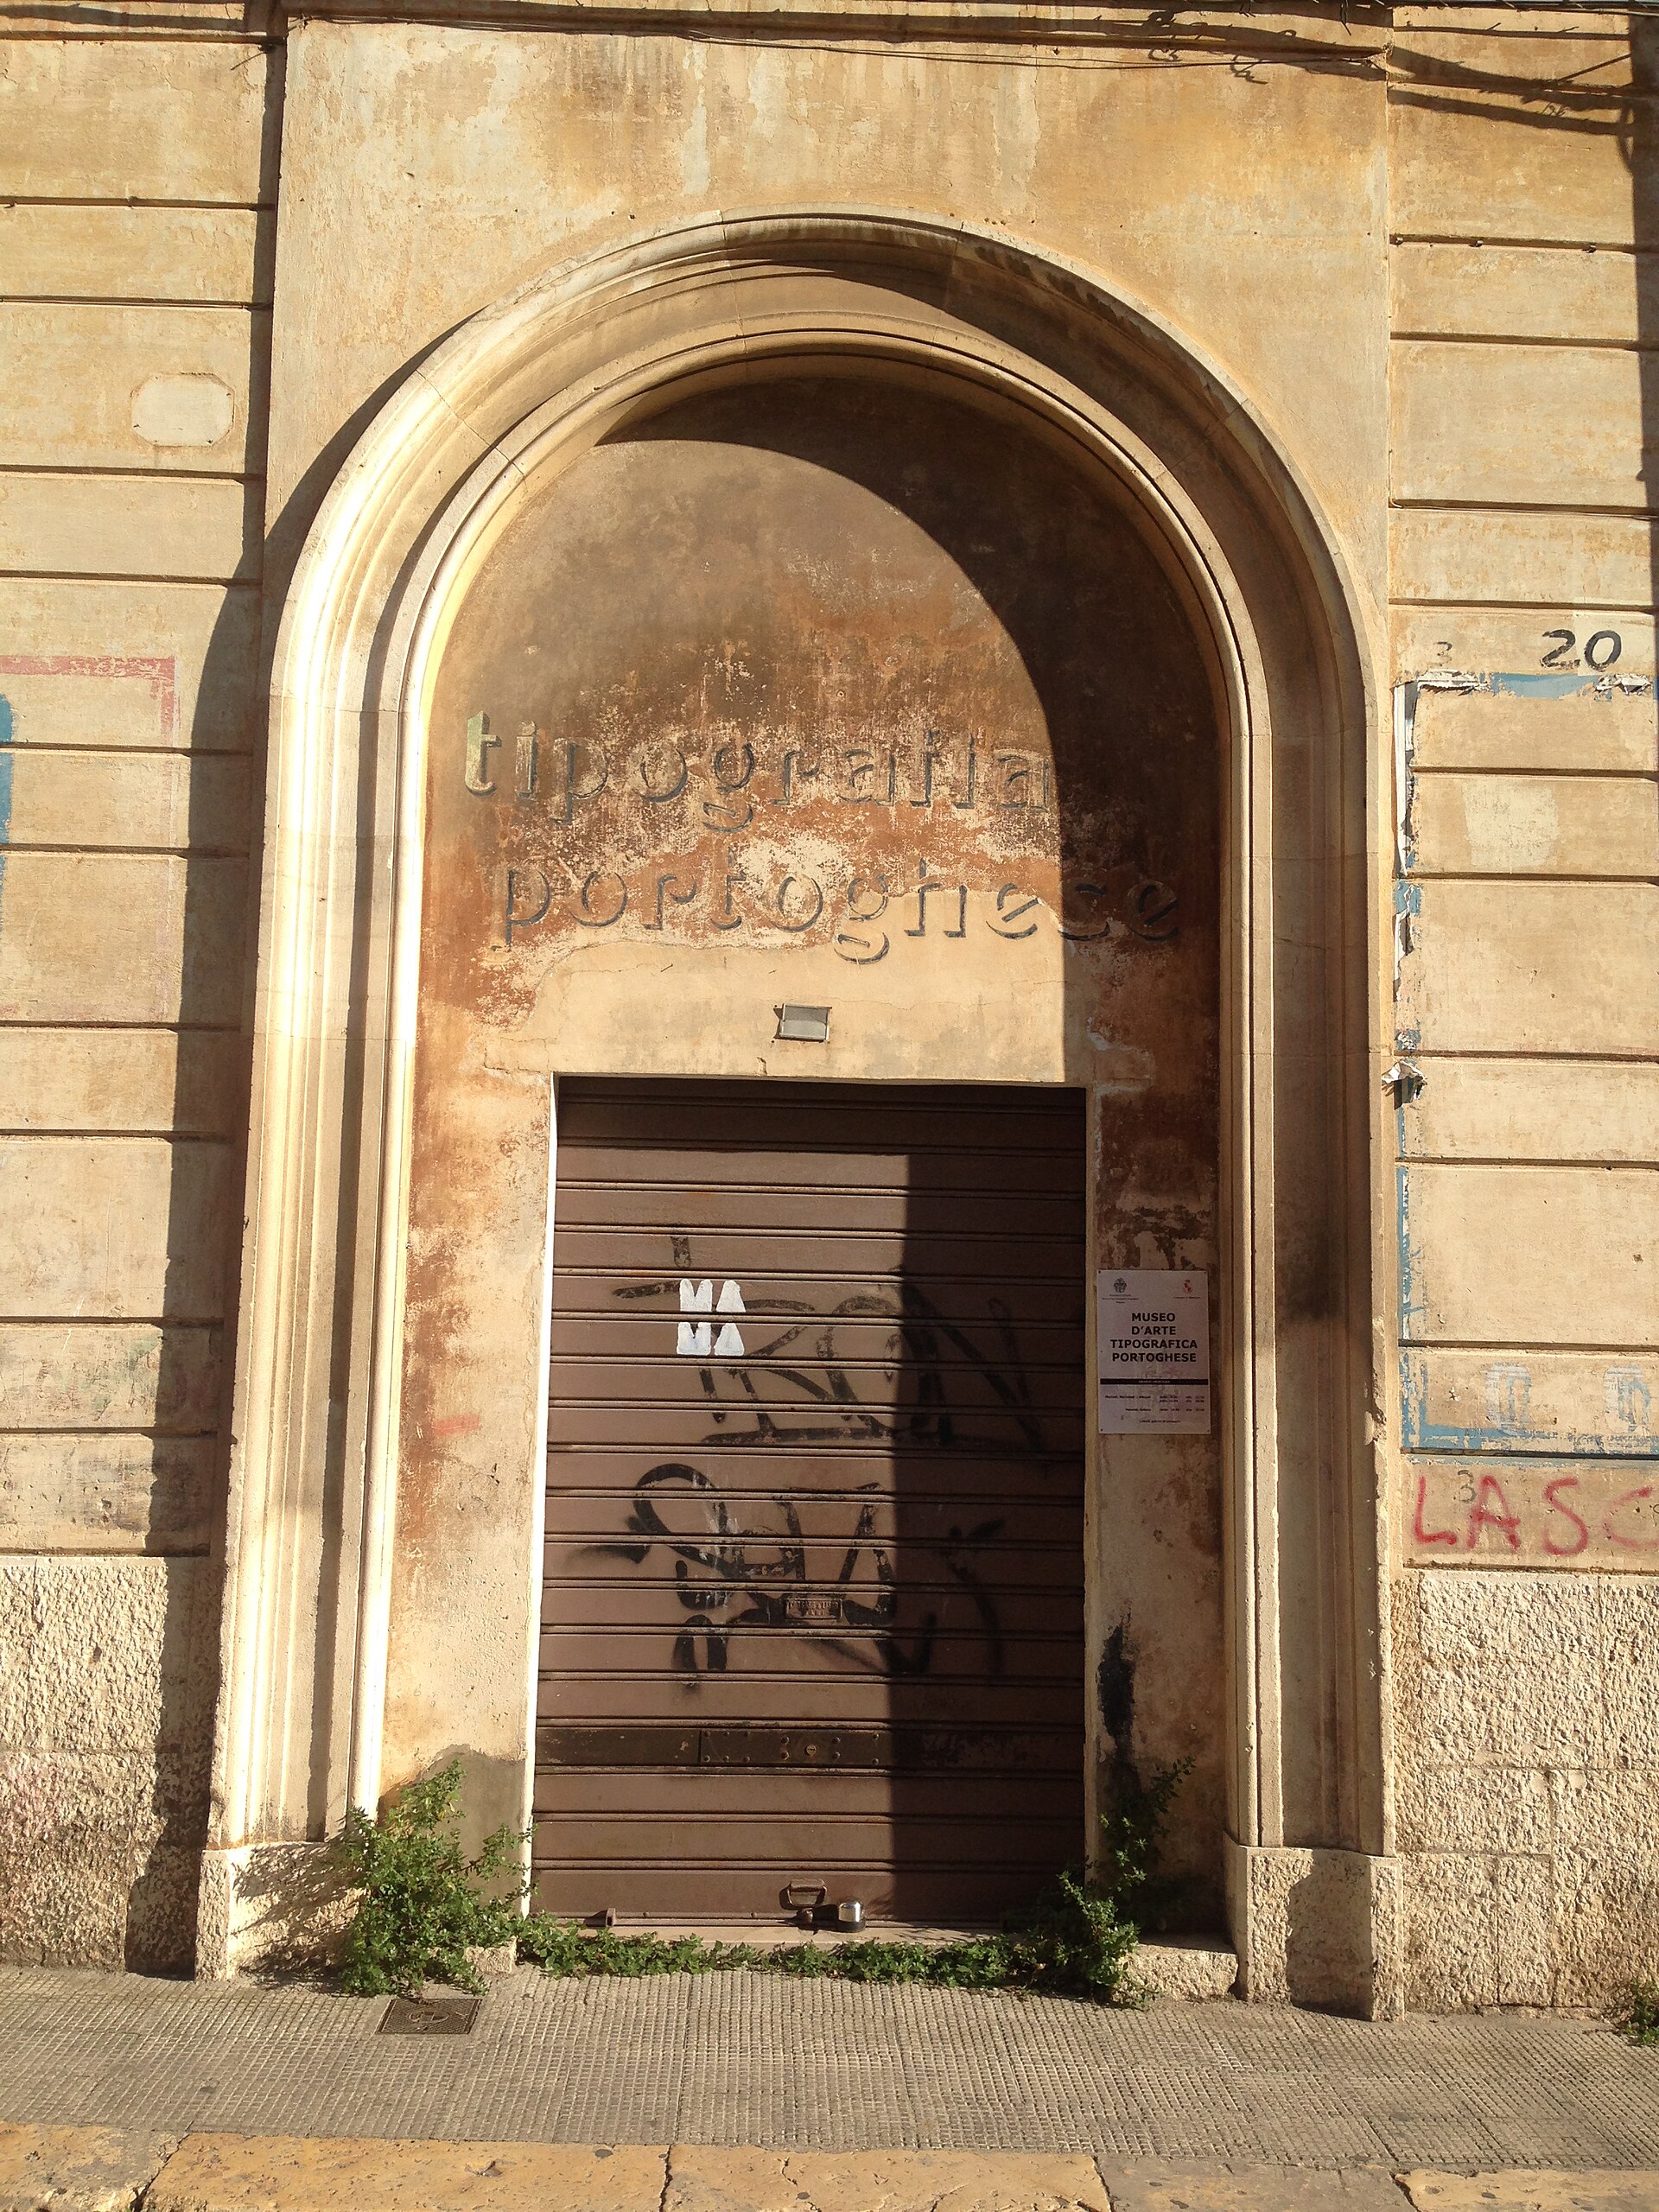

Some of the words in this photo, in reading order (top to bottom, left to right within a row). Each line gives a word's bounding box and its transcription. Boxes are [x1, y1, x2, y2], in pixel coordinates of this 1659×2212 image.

[1539, 628, 1623, 671] 20
[1131, 1313, 1176, 1322] MUSEO
[1110, 1339, 1198, 1349] TIPOGRAFICA
[1112, 1353, 1197, 1362] PORTOGHESE
